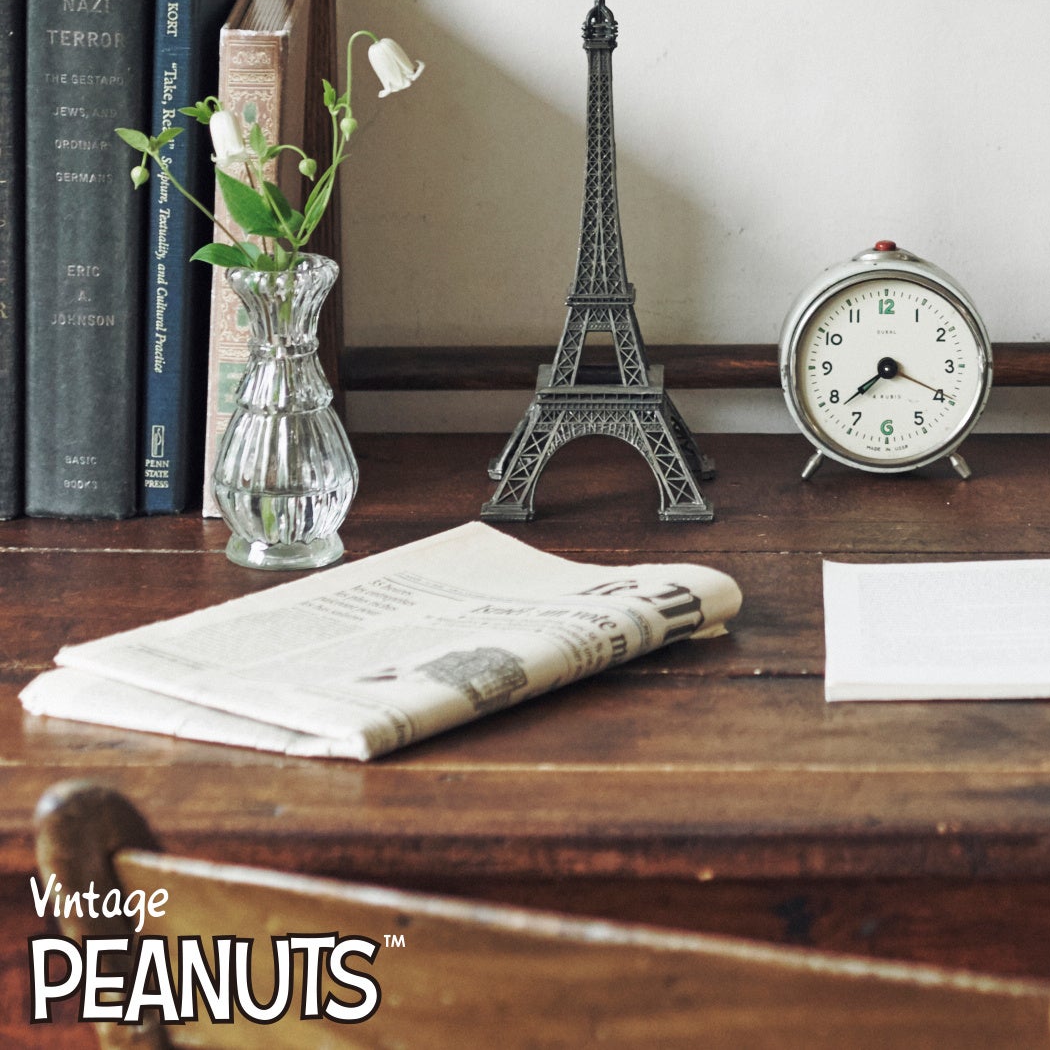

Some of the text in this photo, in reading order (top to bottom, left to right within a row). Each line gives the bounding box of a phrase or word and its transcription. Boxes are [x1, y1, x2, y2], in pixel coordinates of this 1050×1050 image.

[166, 2, 179, 38] KORT
[46, 29, 127, 49] TERROR
[44, 72, 68, 85] THE
[53, 105, 90, 119] JEWS,
[55, 171, 114, 184] GERMANS
[154, 208, 171, 261] Textuality,
[66, 263, 101, 278] ERIC
[156, 263, 169, 285] and
[77, 289, 92, 303] A.
[155, 287, 168, 333] Cultural
[878, 298, 896, 315] 12
[50, 312, 116, 328] JOHNSON
[849, 308, 861, 324] 11
[915, 308, 920, 323] 1
[825, 331, 844, 346] 10
[935, 327, 947, 343] 2
[153, 333, 167, 374] Practice
[821, 360, 833, 376] 9
[944, 359, 955, 374] 3
[829, 389, 840, 405] 8
[932, 388, 946, 404] 4
[851, 411, 863, 427] 7
[913, 411, 925, 426] 5
[880, 419, 895, 436] 6
[64, 455, 98, 465] BASIC
[144, 458, 171, 468] PENN
[144, 469, 170, 479] STATE
[63, 479, 99, 490] BOOKS
[144, 479, 170, 489] PRESS
